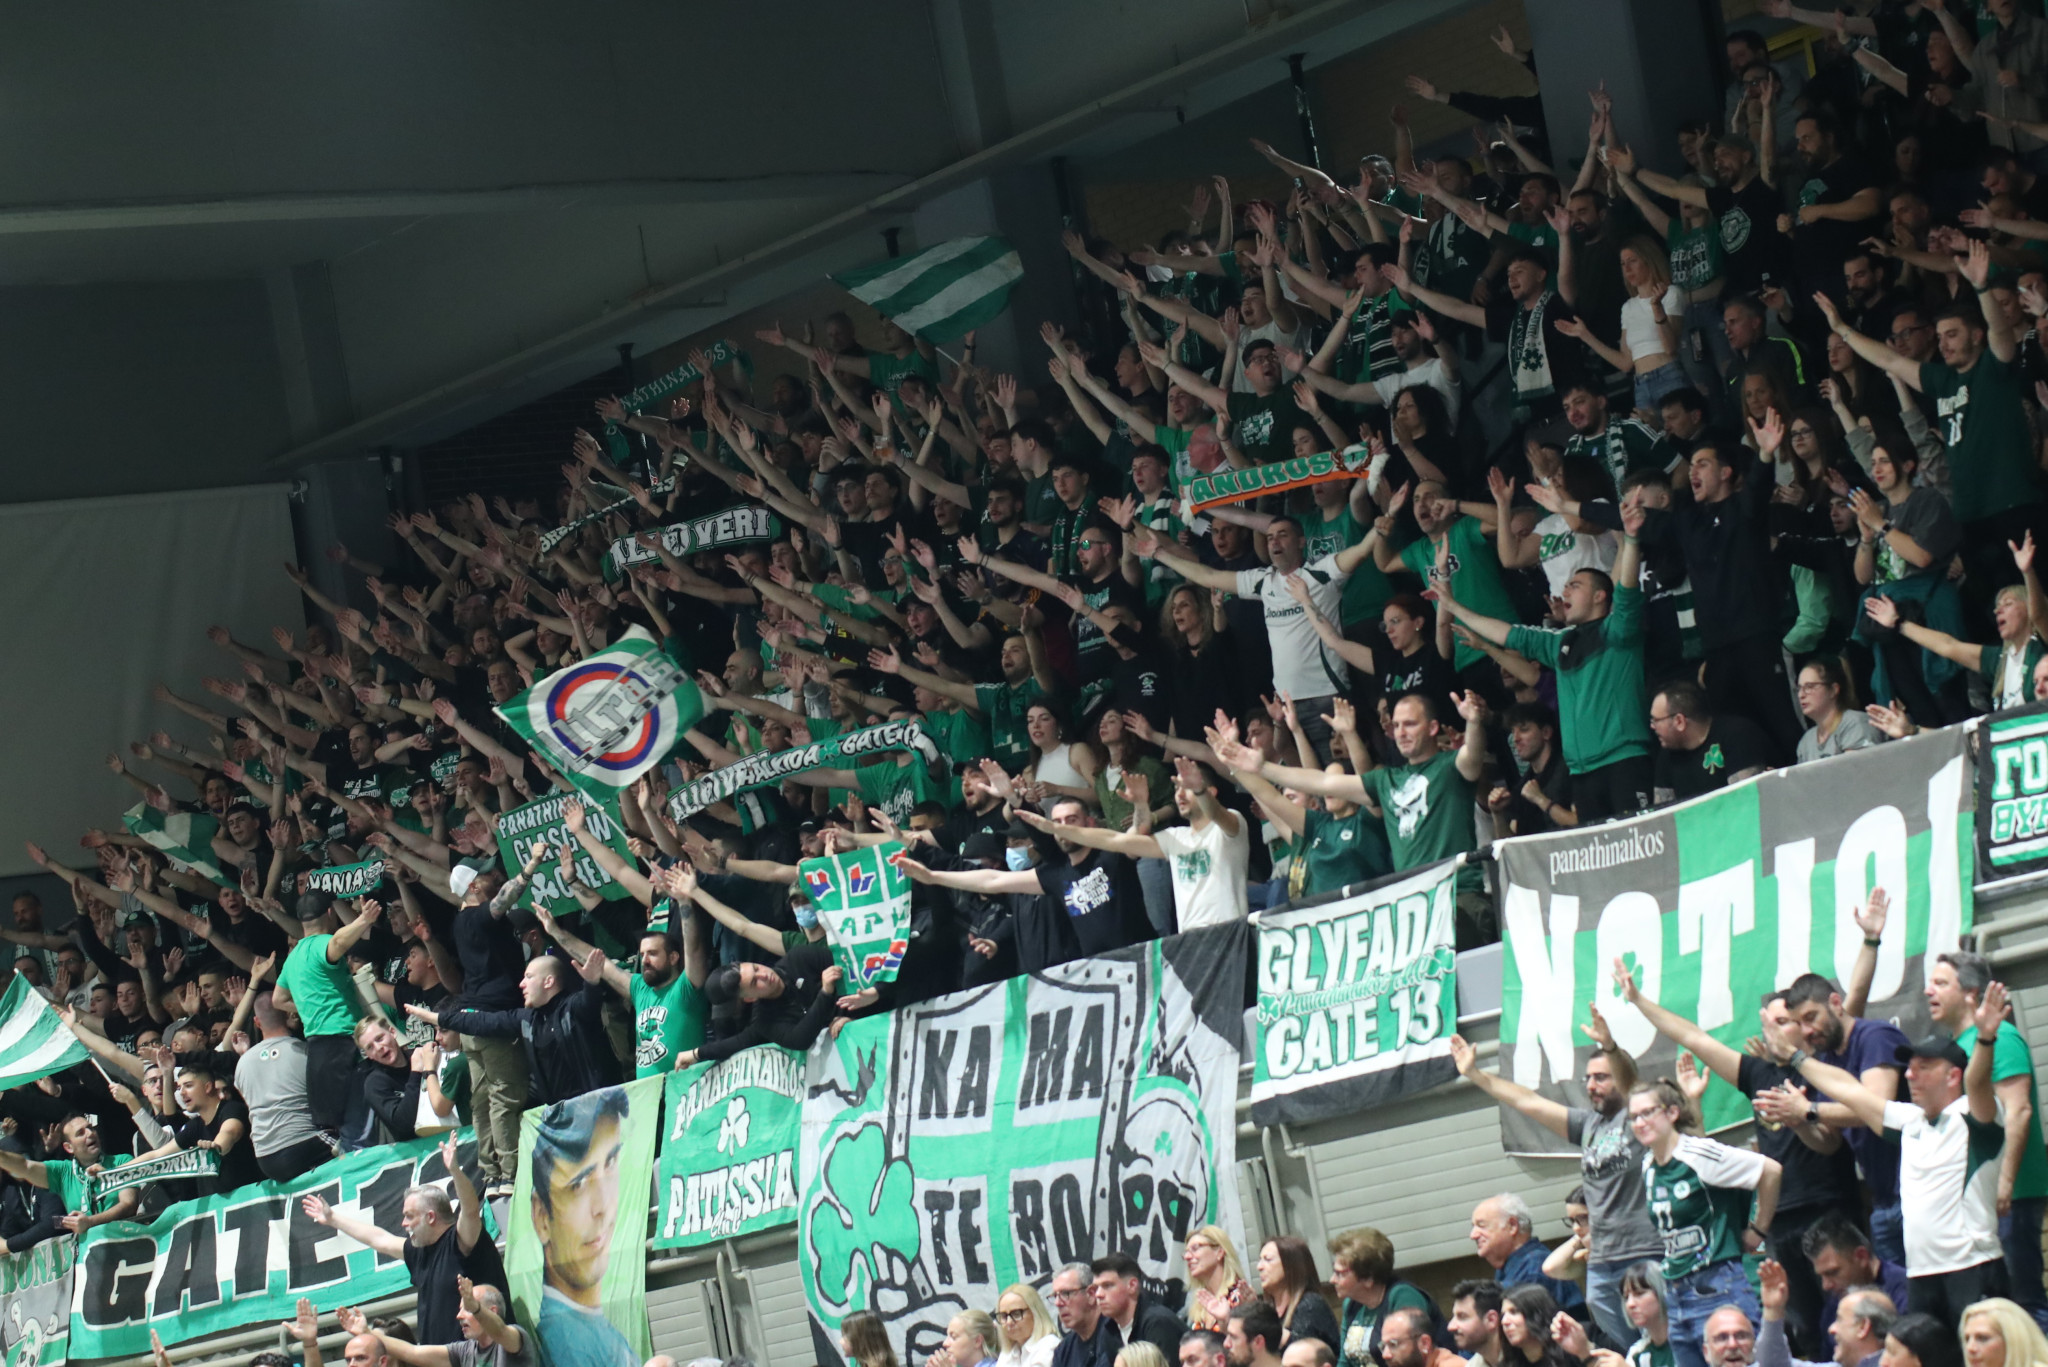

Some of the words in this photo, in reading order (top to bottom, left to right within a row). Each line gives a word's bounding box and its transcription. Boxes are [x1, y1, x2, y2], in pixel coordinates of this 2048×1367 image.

[1191, 450, 1335, 504] ANDROS
[841, 723, 899, 755] GATE
[308, 867, 364, 894] VANIA
[513, 812, 612, 869] GLASGW
[1549, 827, 1665, 884] panathinaikos
[1258, 876, 1455, 996] GLYFADA
[918, 1025, 992, 1121] KA
[1019, 1003, 1105, 1111] MA
[1265, 997, 1380, 1080] GATE
[1389, 979, 1443, 1051] 13
[671, 1047, 806, 1142] PANATHINAIKOS
[663, 1148, 798, 1239] PATISSIA
[923, 1188, 990, 1286] TE
[82, 1179, 352, 1331] GATE
